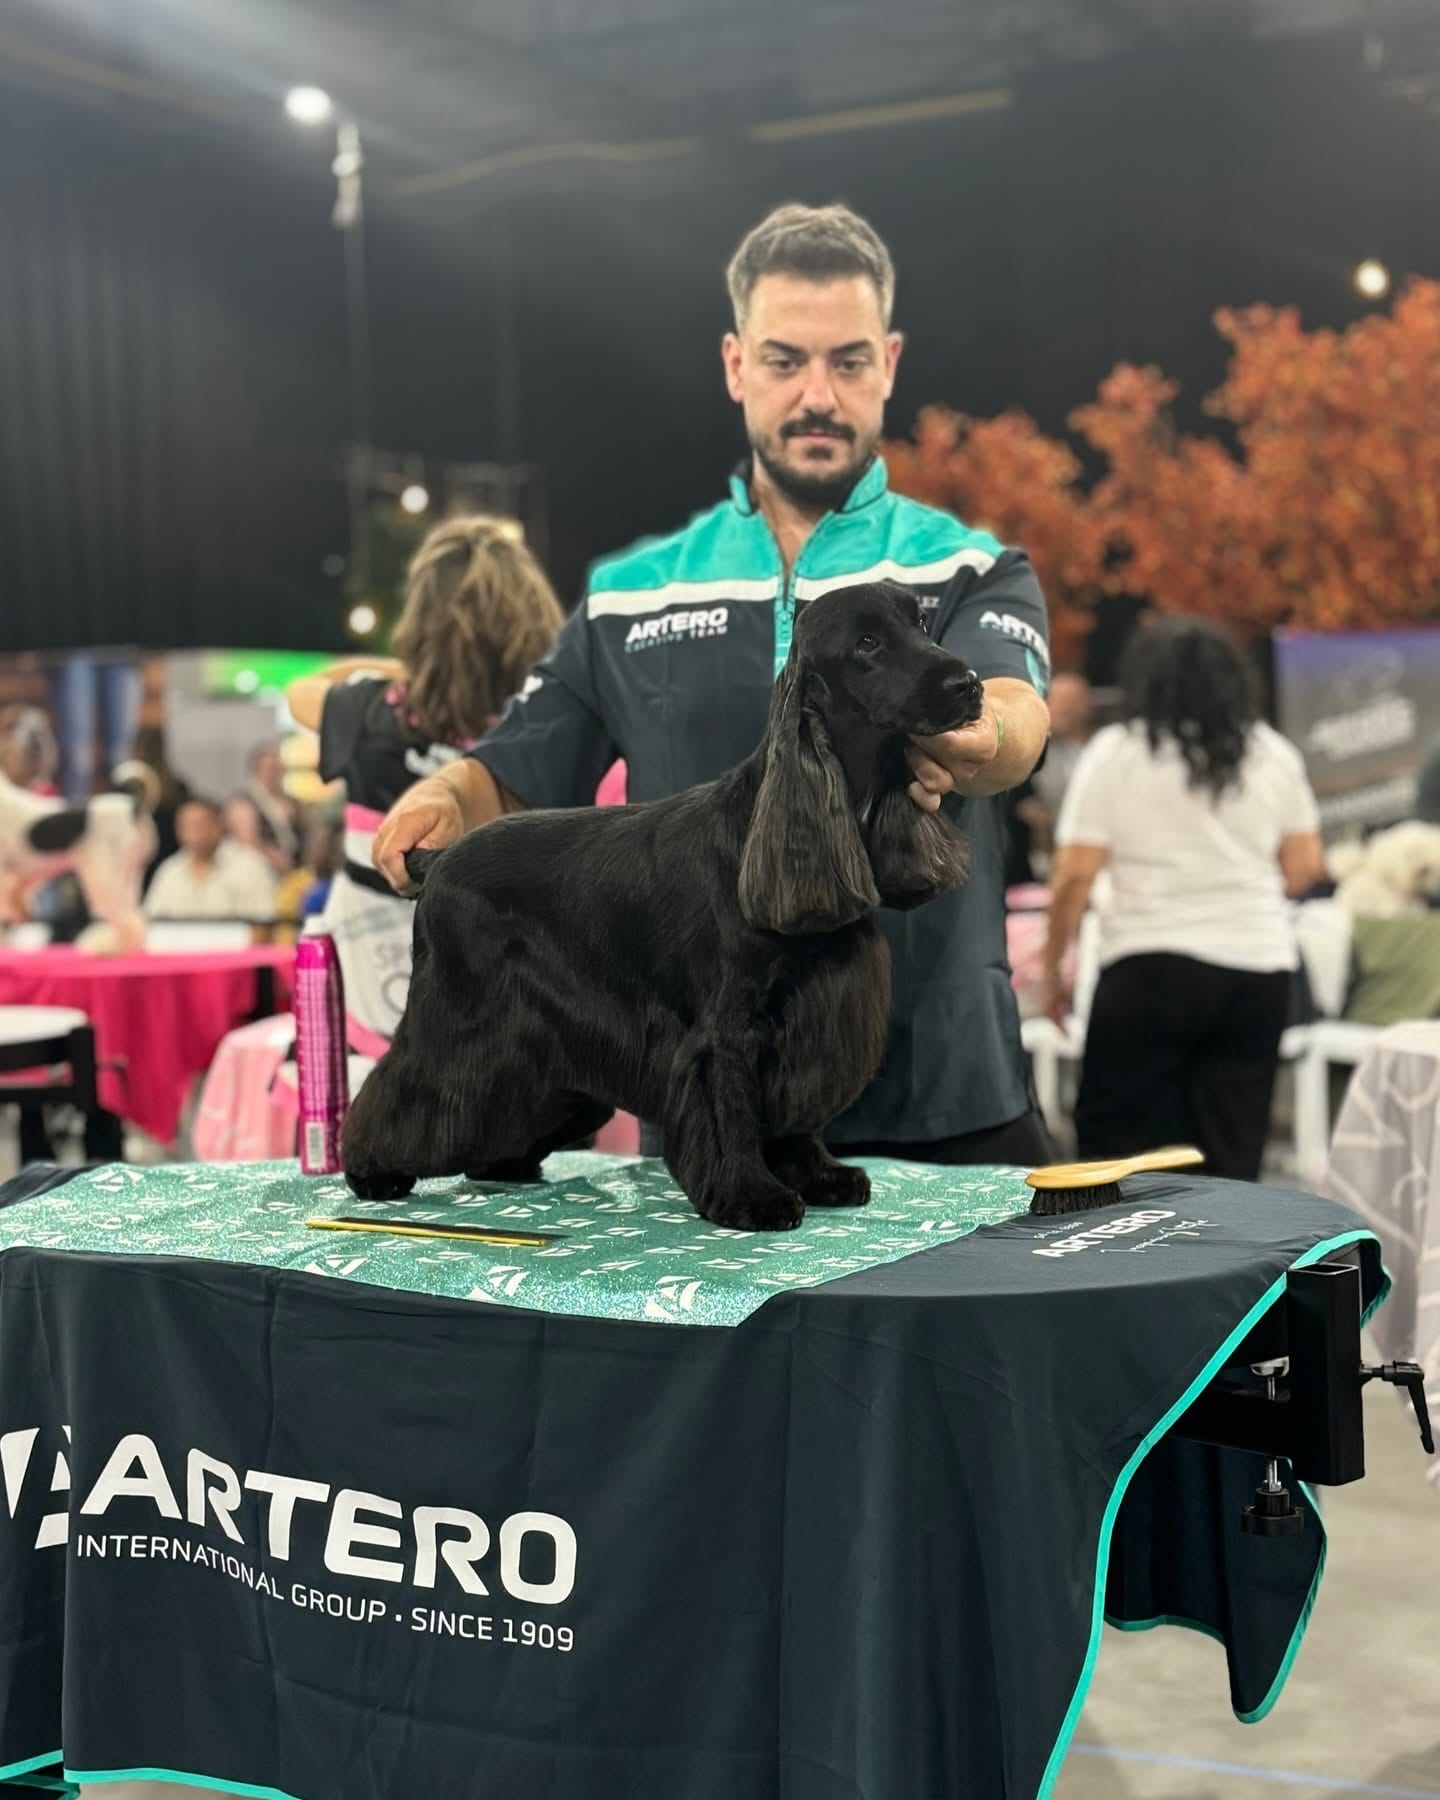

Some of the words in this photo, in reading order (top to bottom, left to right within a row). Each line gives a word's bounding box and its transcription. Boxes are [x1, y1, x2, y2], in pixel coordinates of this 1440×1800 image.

[625, 607, 729, 643] ARTERO
[690, 624, 729, 640] TEAM
[1032, 1209, 1177, 1258] ARTERO
[79, 1433, 578, 1605] ARTERO
[77, 1534, 285, 1601] INTERNATIONAL
[291, 1583, 387, 1623] GROUP
[411, 1607, 493, 1641] SINCE
[502, 1618, 574, 1652] 1909
